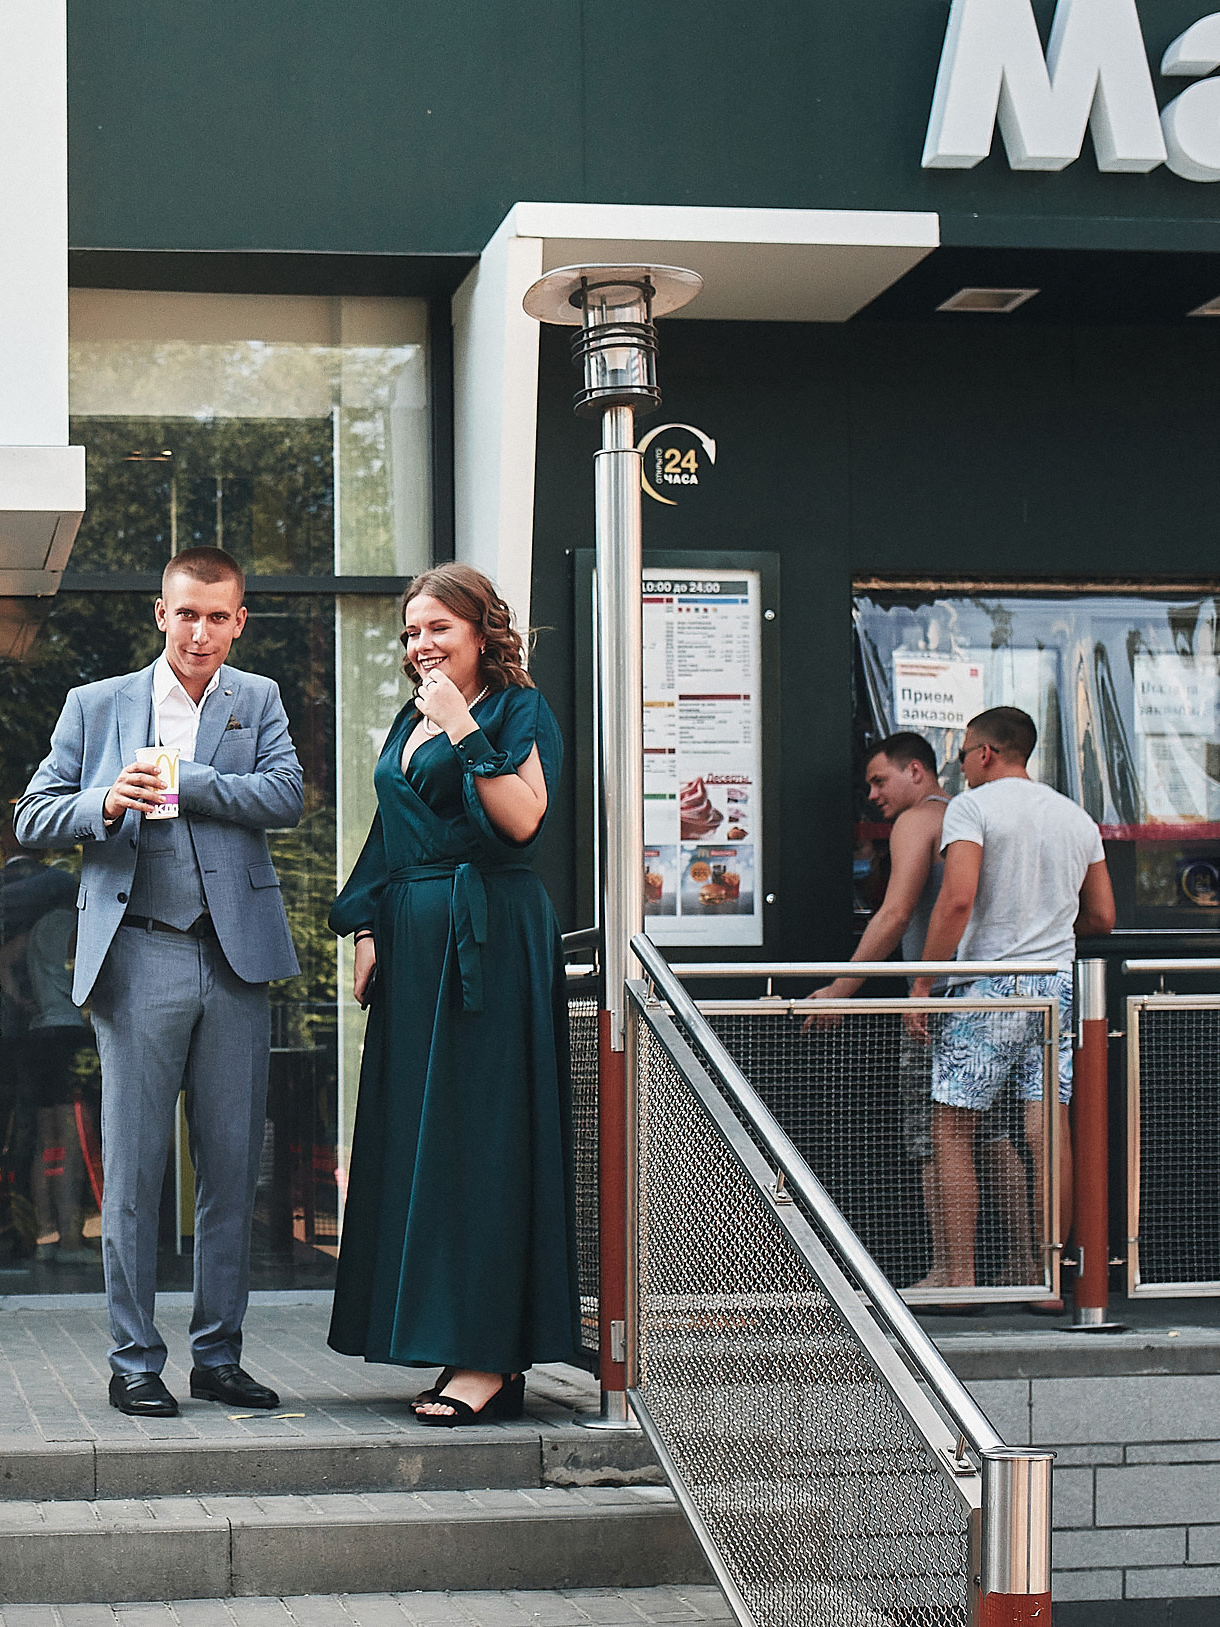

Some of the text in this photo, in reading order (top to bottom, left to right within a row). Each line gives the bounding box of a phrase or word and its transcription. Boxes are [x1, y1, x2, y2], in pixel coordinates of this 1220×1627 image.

[664, 448, 699, 474] 24
[663, 473, 699, 485] ЧАСА
[673, 584, 688, 594] до
[901, 688, 954, 704] Прием
[902, 708, 964, 723] заказов
